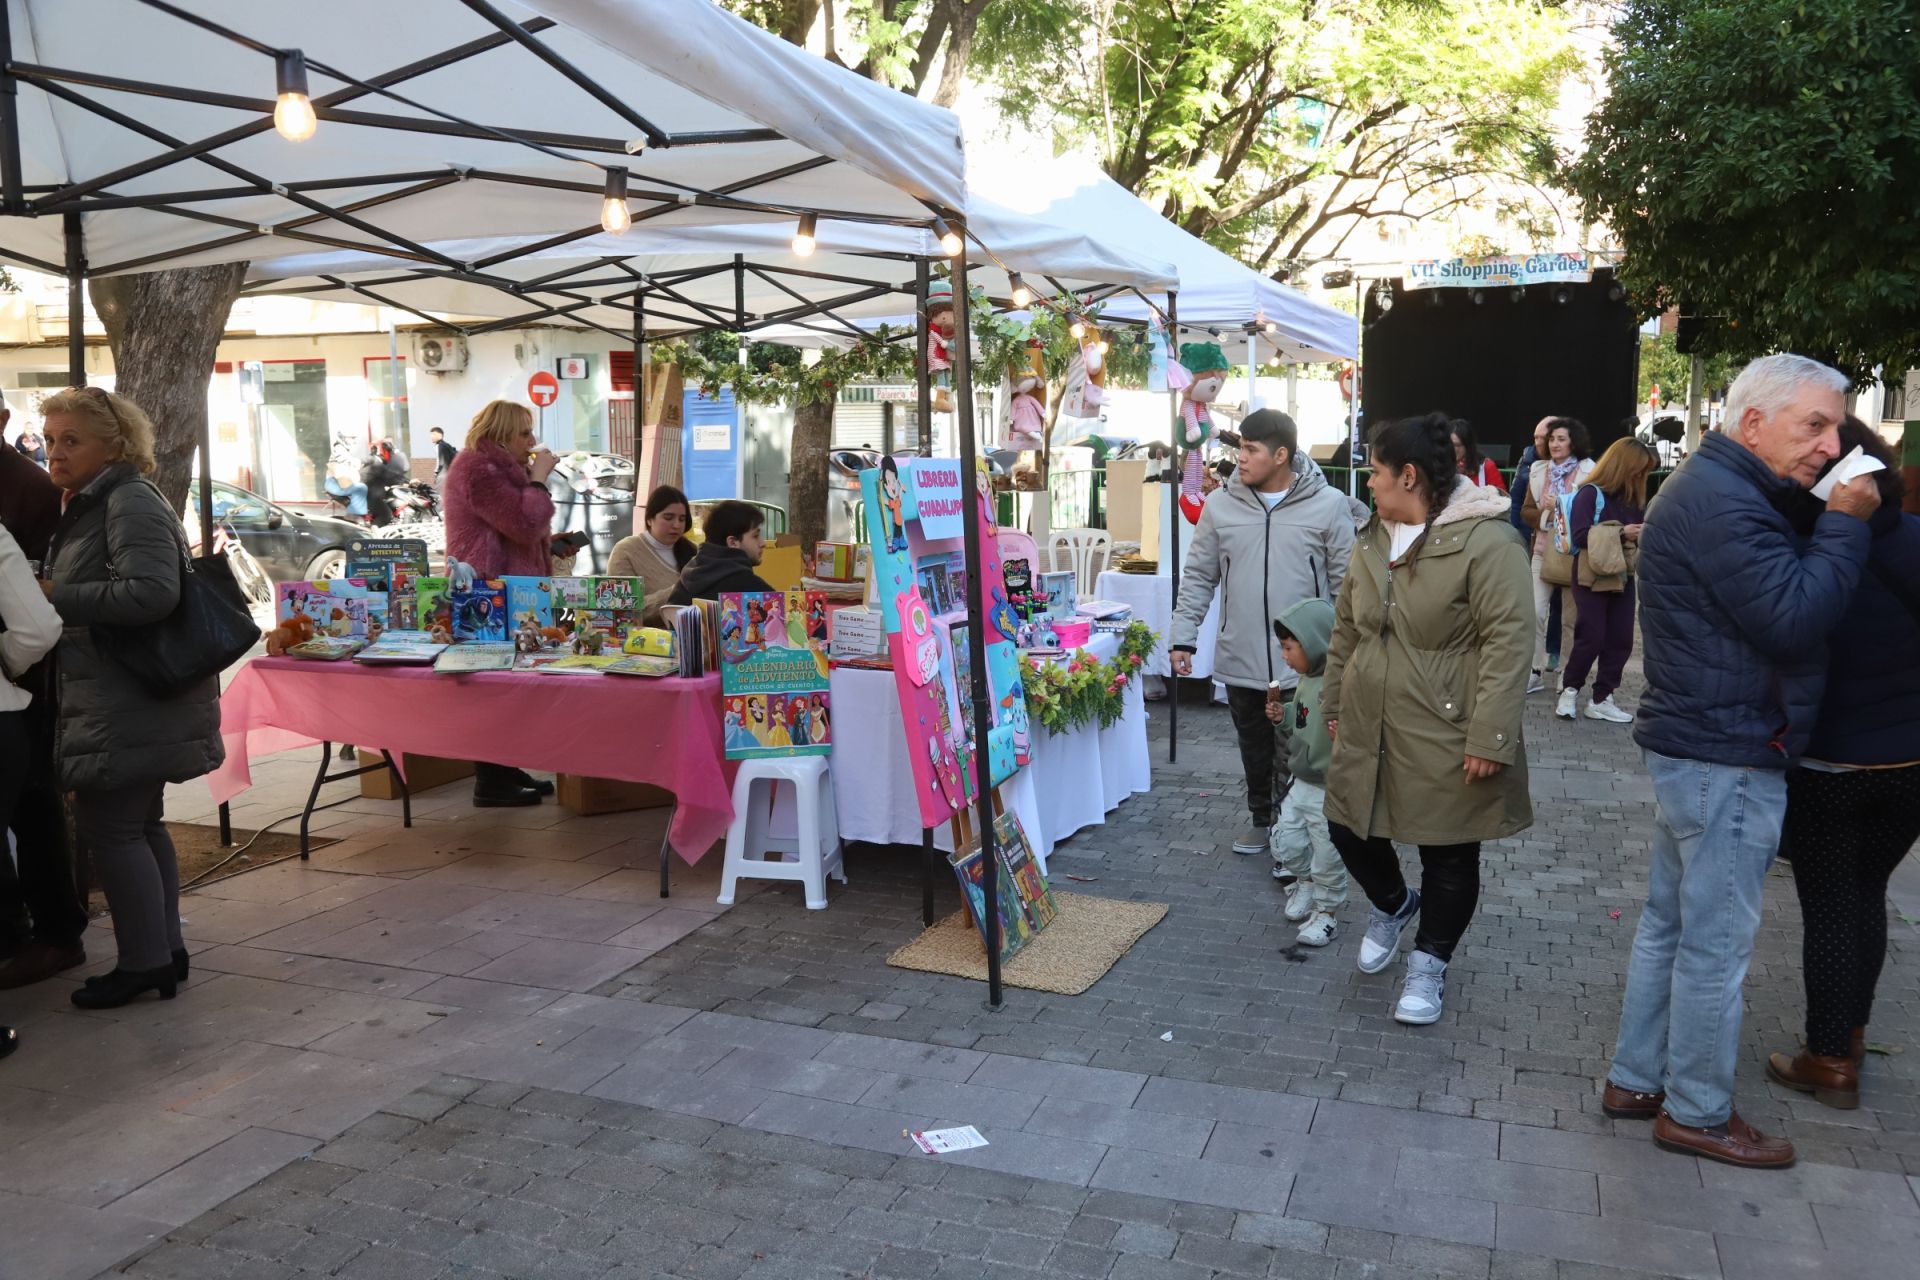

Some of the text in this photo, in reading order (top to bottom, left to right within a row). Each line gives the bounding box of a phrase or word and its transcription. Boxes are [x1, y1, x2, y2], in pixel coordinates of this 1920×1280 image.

[1440, 260, 1522, 280] Shopping
[1525, 257, 1588, 275] Garden
[918, 499, 964, 518] GUADALUP
[737, 661, 817, 673] CALENDARIO
[752, 671, 816, 683] ADVIENTO
